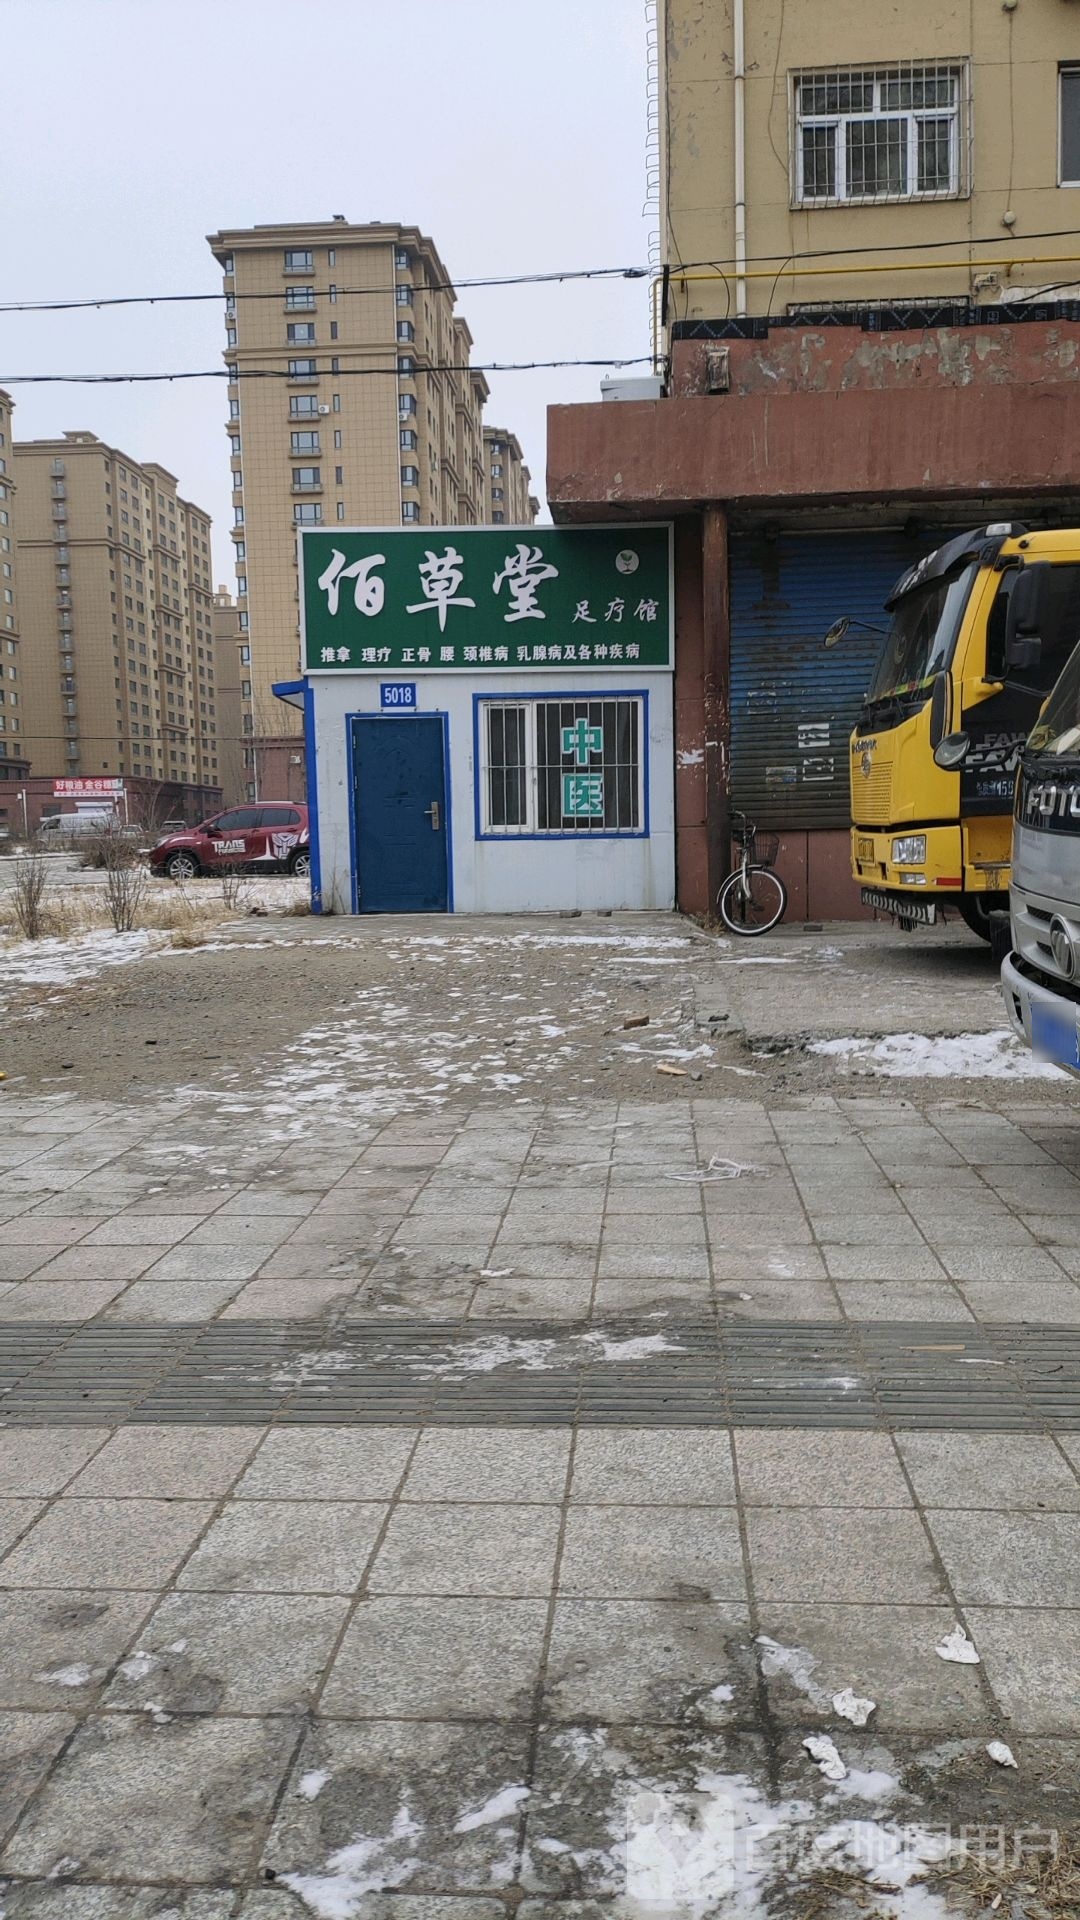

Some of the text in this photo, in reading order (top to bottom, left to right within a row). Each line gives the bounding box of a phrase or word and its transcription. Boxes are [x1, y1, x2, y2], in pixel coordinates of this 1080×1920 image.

[317, 544, 559, 632] 佰草堂
[571, 597, 659, 623] 足疗馆
[320, 643, 640, 663] 推拿 理疗 正骨 腰 颈椎病 乳腺病及各种疾病
[384, 687, 412, 704] 5018
[562, 718, 604, 817] 中医
